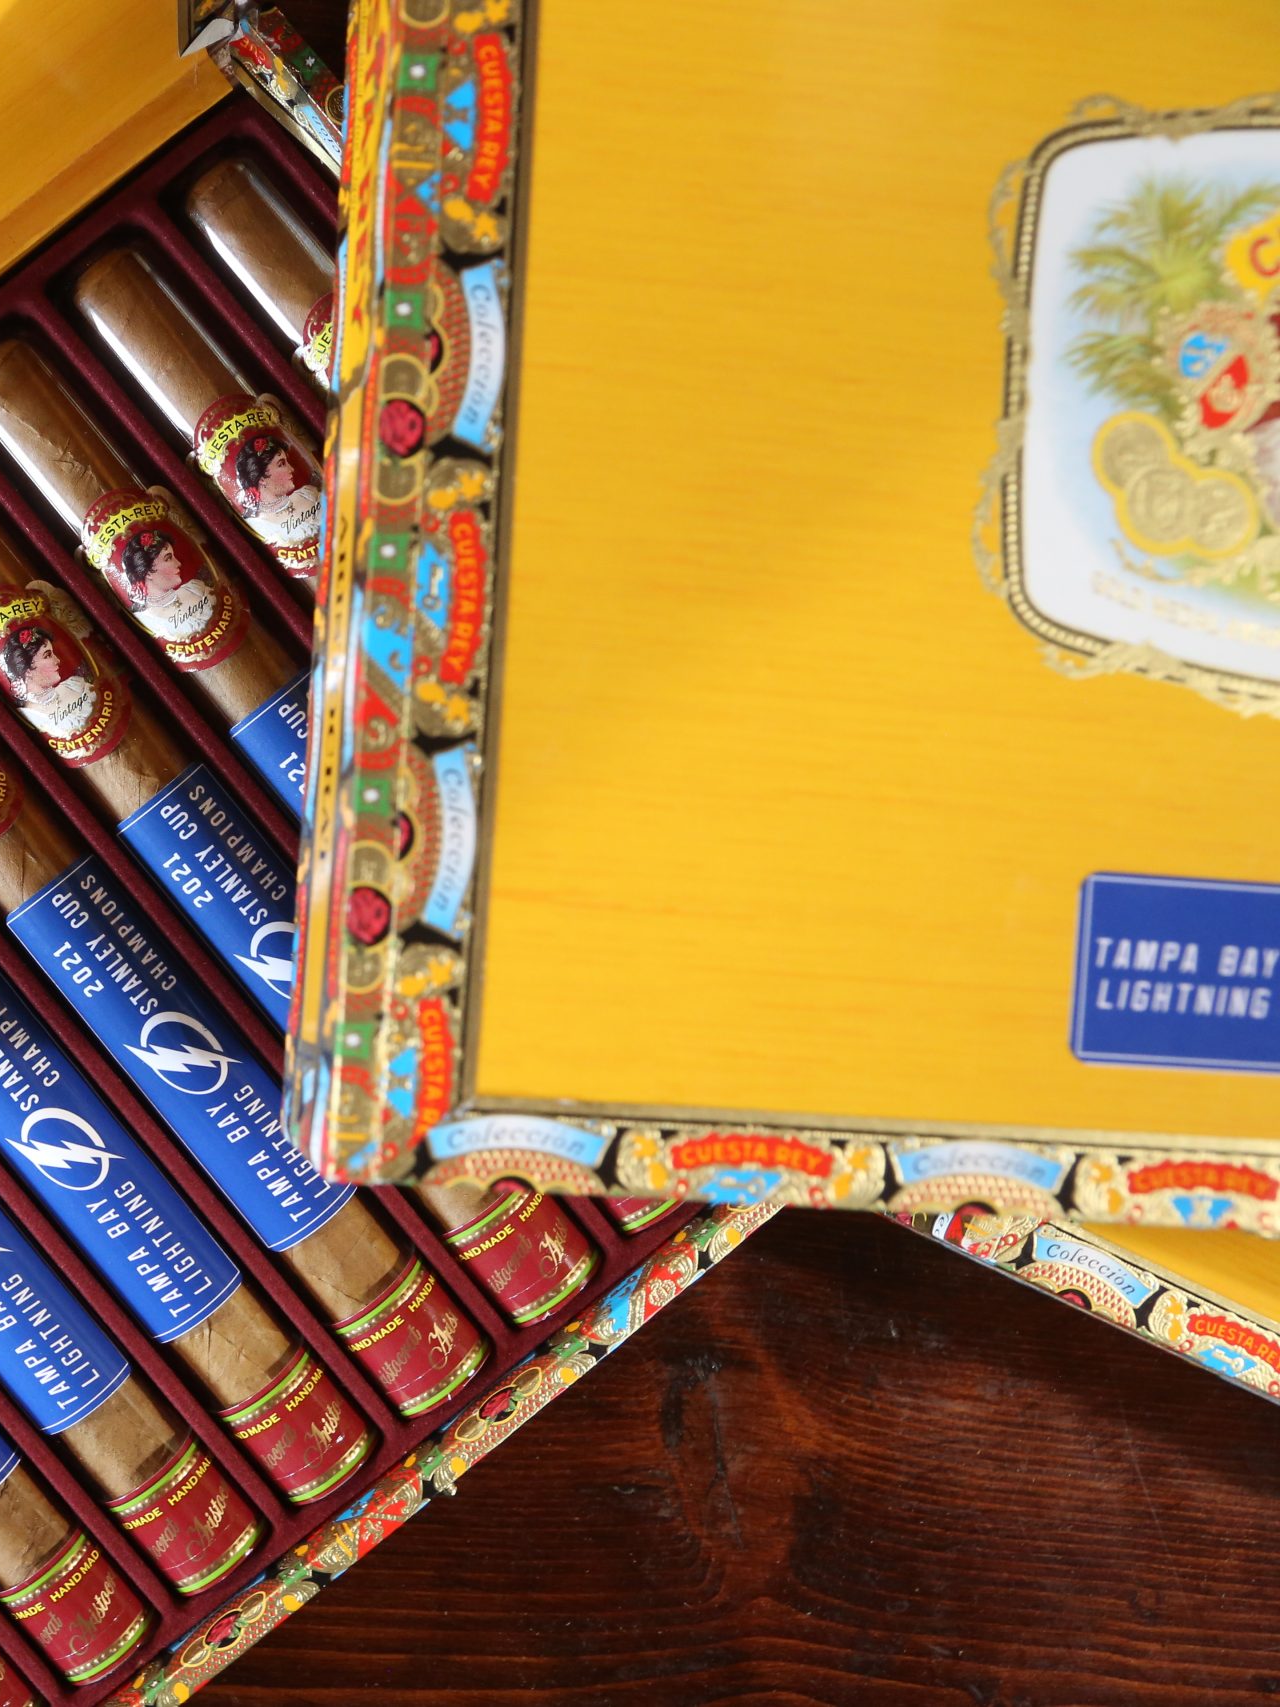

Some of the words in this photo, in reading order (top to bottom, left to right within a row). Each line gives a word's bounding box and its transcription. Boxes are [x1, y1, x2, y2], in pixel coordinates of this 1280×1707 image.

[166, 595, 233, 655] CENTENARIO
[168, 595, 209, 629] Vintage
[48, 692, 89, 726] Vintage
[48, 690, 113, 750] CENTENARIO
[159, 803, 198, 841] CUP
[188, 784, 287, 901] CHAMPIONS
[162, 852, 214, 909] 2021
[194, 844, 268, 926] STANLEY
[51, 892, 89, 929] CUP
[80, 874, 177, 991] CHAMPIONS
[52, 941, 105, 998] 2021
[85, 933, 159, 1016] STANLEY
[1095, 936, 1199, 975] TAMPA
[1217, 944, 1280, 979] BAY
[1095, 977, 1272, 1020] LIGHTNING
[205, 1102, 251, 1144] BAY
[229, 1081, 333, 1197] LIGHTNING
[247, 1149, 312, 1223] TAMPA
[85, 1198, 130, 1239] BAY
[113, 1180, 213, 1296] LIGHTNING
[479, 1224, 515, 1253] MADE
[127, 1245, 191, 1318] TAMPA
[0, 1273, 100, 1388] LIGHTNING
[371, 1315, 405, 1344] MADE
[14, 1338, 79, 1410] TAMPA
[246, 1413, 281, 1438] MADE
[284, 1382, 315, 1412] HAND
[167, 1475, 199, 1506] HAND
[49, 1571, 83, 1602] HAND
